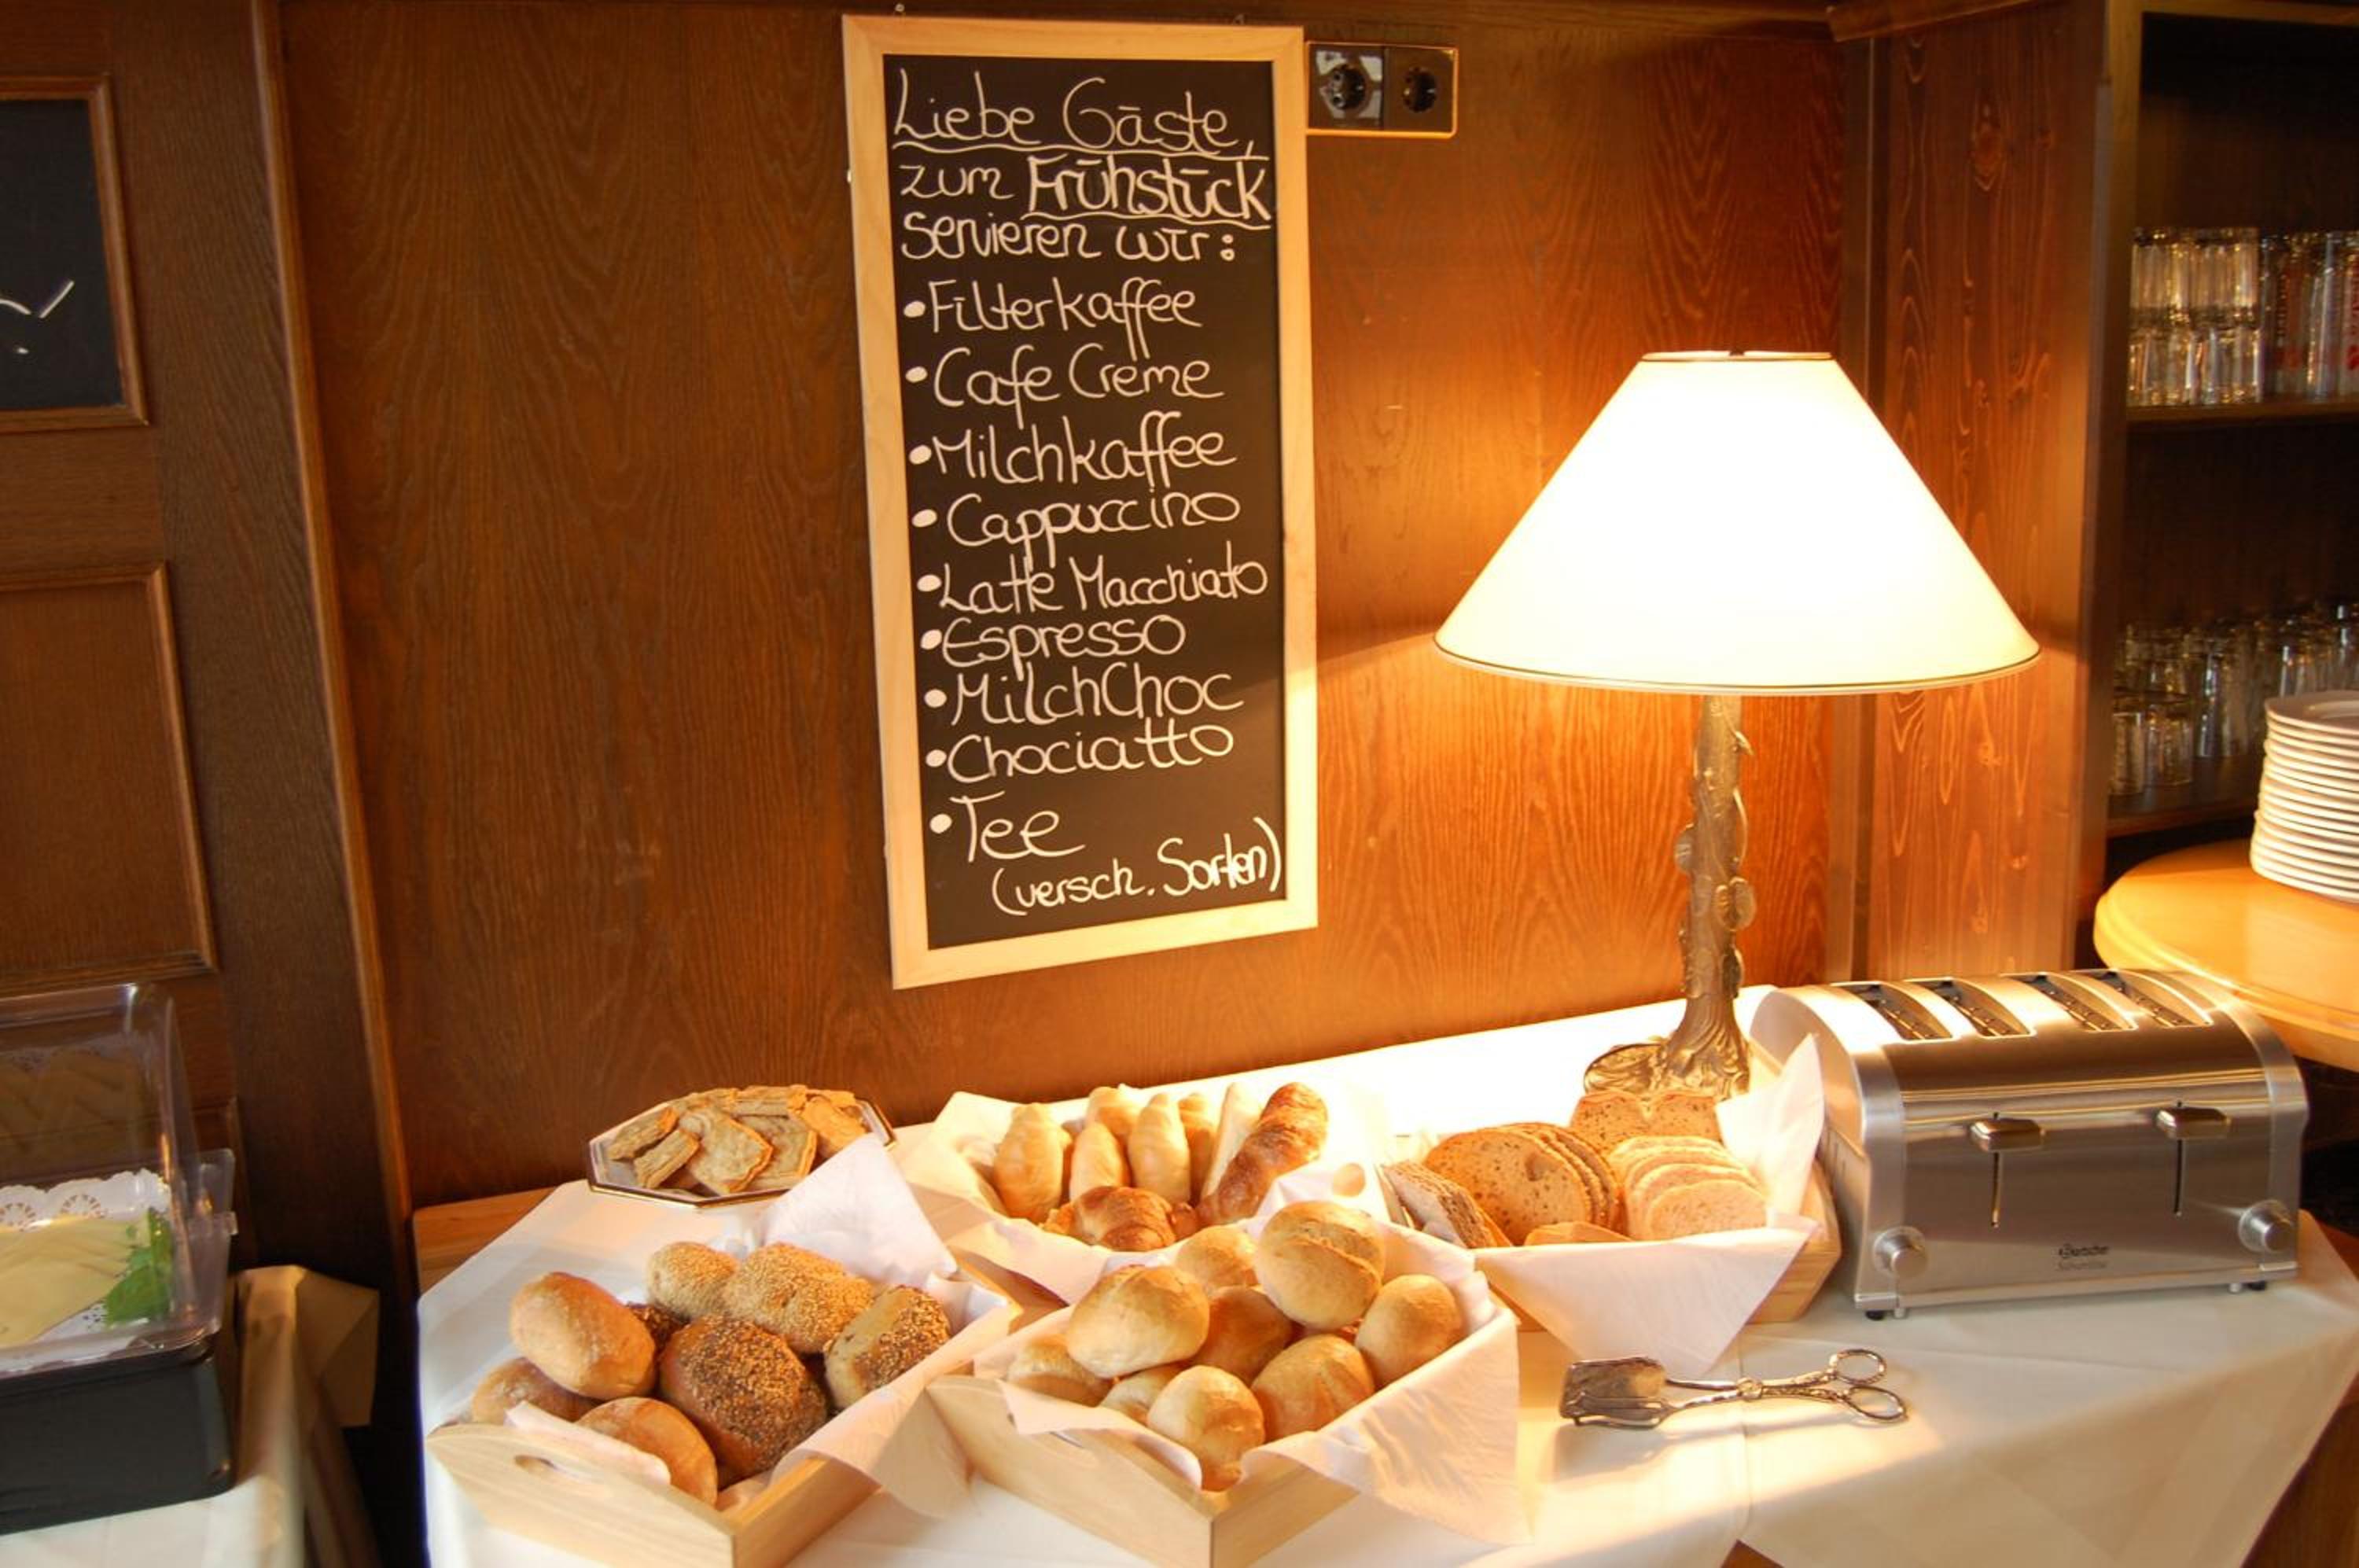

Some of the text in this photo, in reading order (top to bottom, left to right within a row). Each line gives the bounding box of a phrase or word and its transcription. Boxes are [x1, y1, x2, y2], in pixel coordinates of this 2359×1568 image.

[894, 68, 1042, 145] Liebe
[900, 153, 1272, 221] zum Frühstück
[929, 277, 1202, 361] Filterkaffee
[934, 342, 1225, 429] Cafe Creme
[932, 410, 1237, 488] Milchkaffee
[947, 487, 1241, 569] Cappuccino
[939, 540, 1268, 614] Latte Macchiato
[942, 614, 1186, 681] Espresso
[951, 662, 1244, 726] MilchChoc
[947, 717, 1234, 783] Chociatto
[949, 790, 1086, 863] Tee
[992, 817, 1282, 916] (versch. Sorten)
